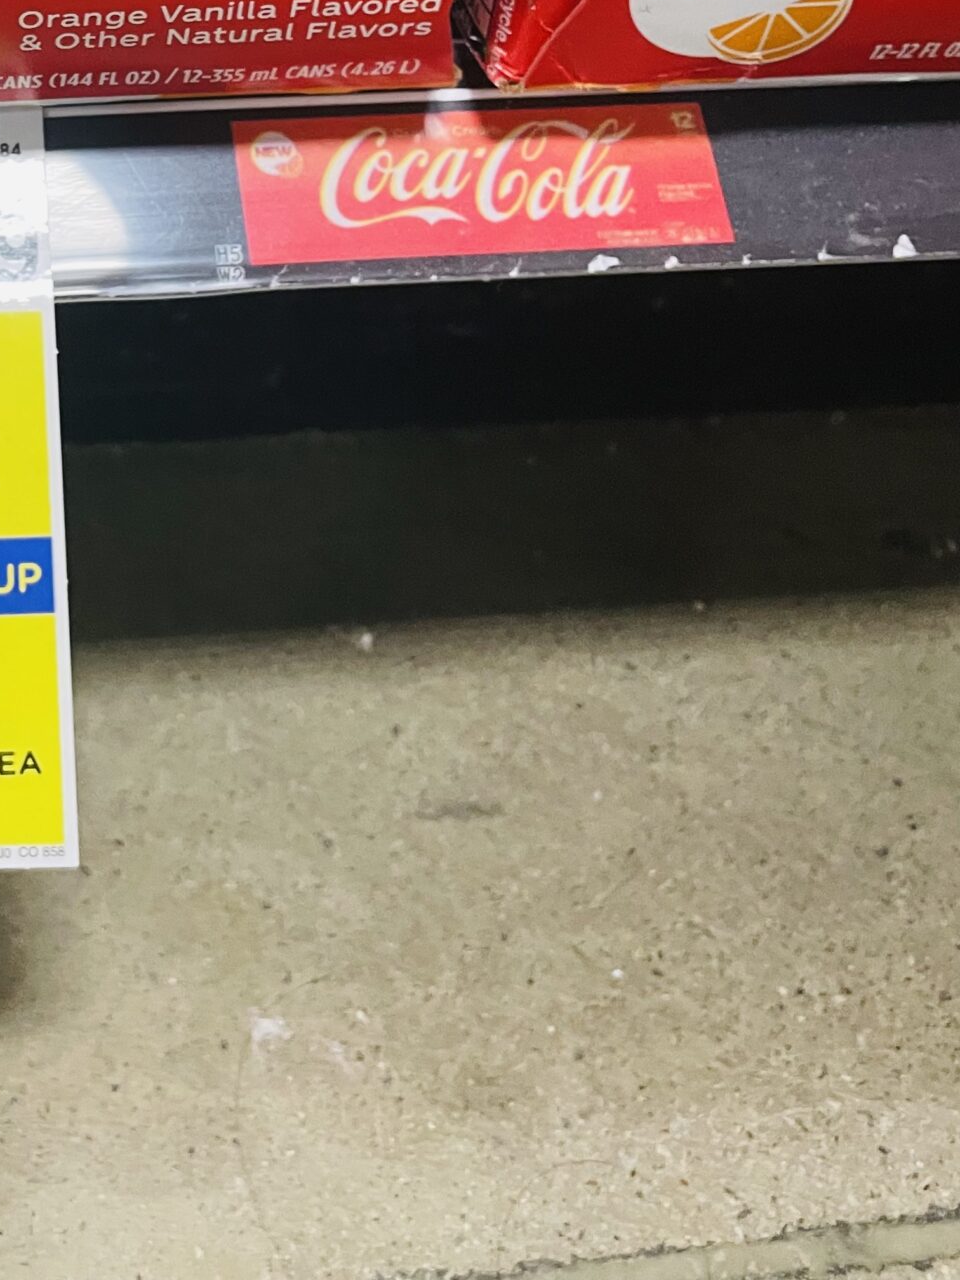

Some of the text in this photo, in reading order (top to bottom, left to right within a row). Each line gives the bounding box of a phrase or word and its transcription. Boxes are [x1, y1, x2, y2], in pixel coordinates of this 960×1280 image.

[18, 10, 147, 32] Orange
[161, 1, 277, 24] Vanilla
[19, 18, 431, 52] & Other Natural Flavors
[49, 72, 94, 90] (144
[99, 72, 122, 87] FL
[125, 69, 160, 86] OZ)
[183, 67, 245, 84] 12-355
[250, 66, 279, 82] mL
[285, 63, 334, 80] CANS
[341, 60, 396, 79] (4.26
[399, 58, 420, 76] L)
[319, 118, 635, 228] Coca-Cola
